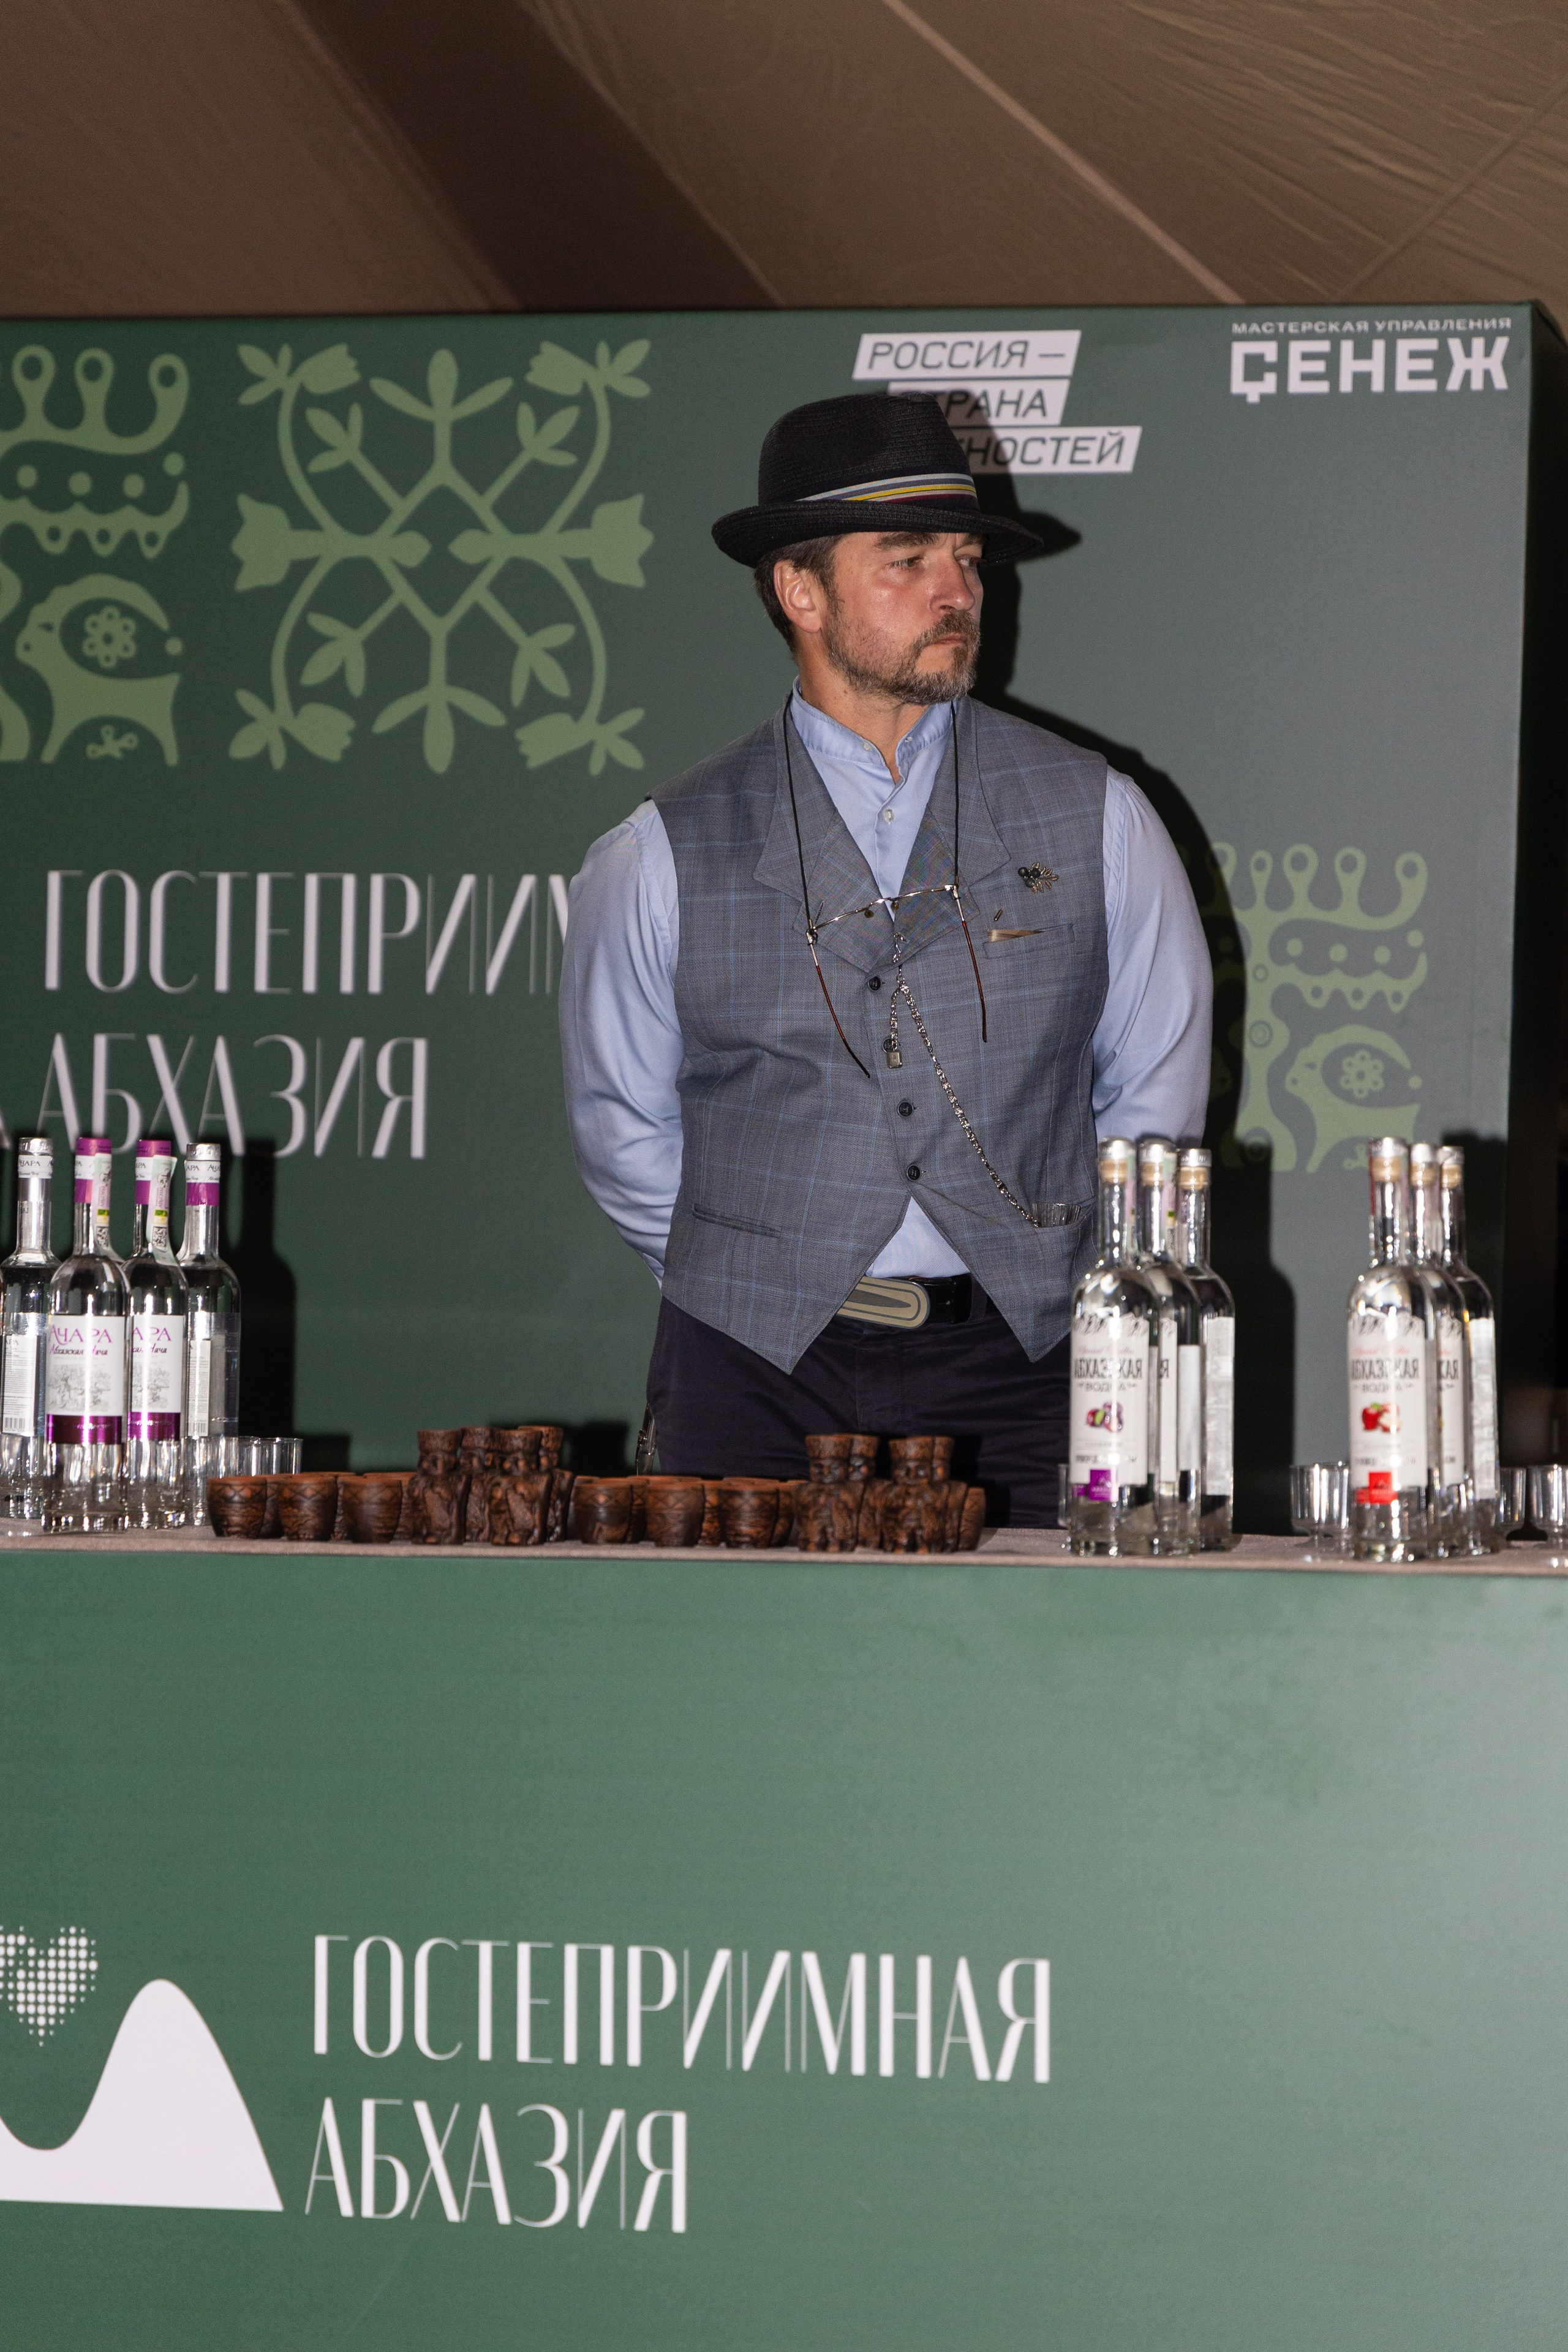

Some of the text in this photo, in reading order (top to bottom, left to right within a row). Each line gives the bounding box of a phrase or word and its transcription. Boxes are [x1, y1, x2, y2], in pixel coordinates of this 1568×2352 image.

[1232, 317, 1512, 334] МАСТЕРСКАЯ УПРАВЛЕНИЯ
[868, 340, 1029, 369] РОССИЯ
[933, 388, 1047, 418] РАНА
[957, 431, 1125, 466] НОСТЕЙ
[37, 1031, 427, 1159] АБХАЗИЯ
[48, 1324, 113, 1345] АЧАРА
[1074, 1357, 1142, 1379] АБХАЗКАЯ
[1086, 1382, 1126, 1392] ВОДА
[314, 1934, 1050, 2083] ГОСТЕПРИИМНАЯ
[304, 2097, 687, 2234] АБХАЗИЯ
